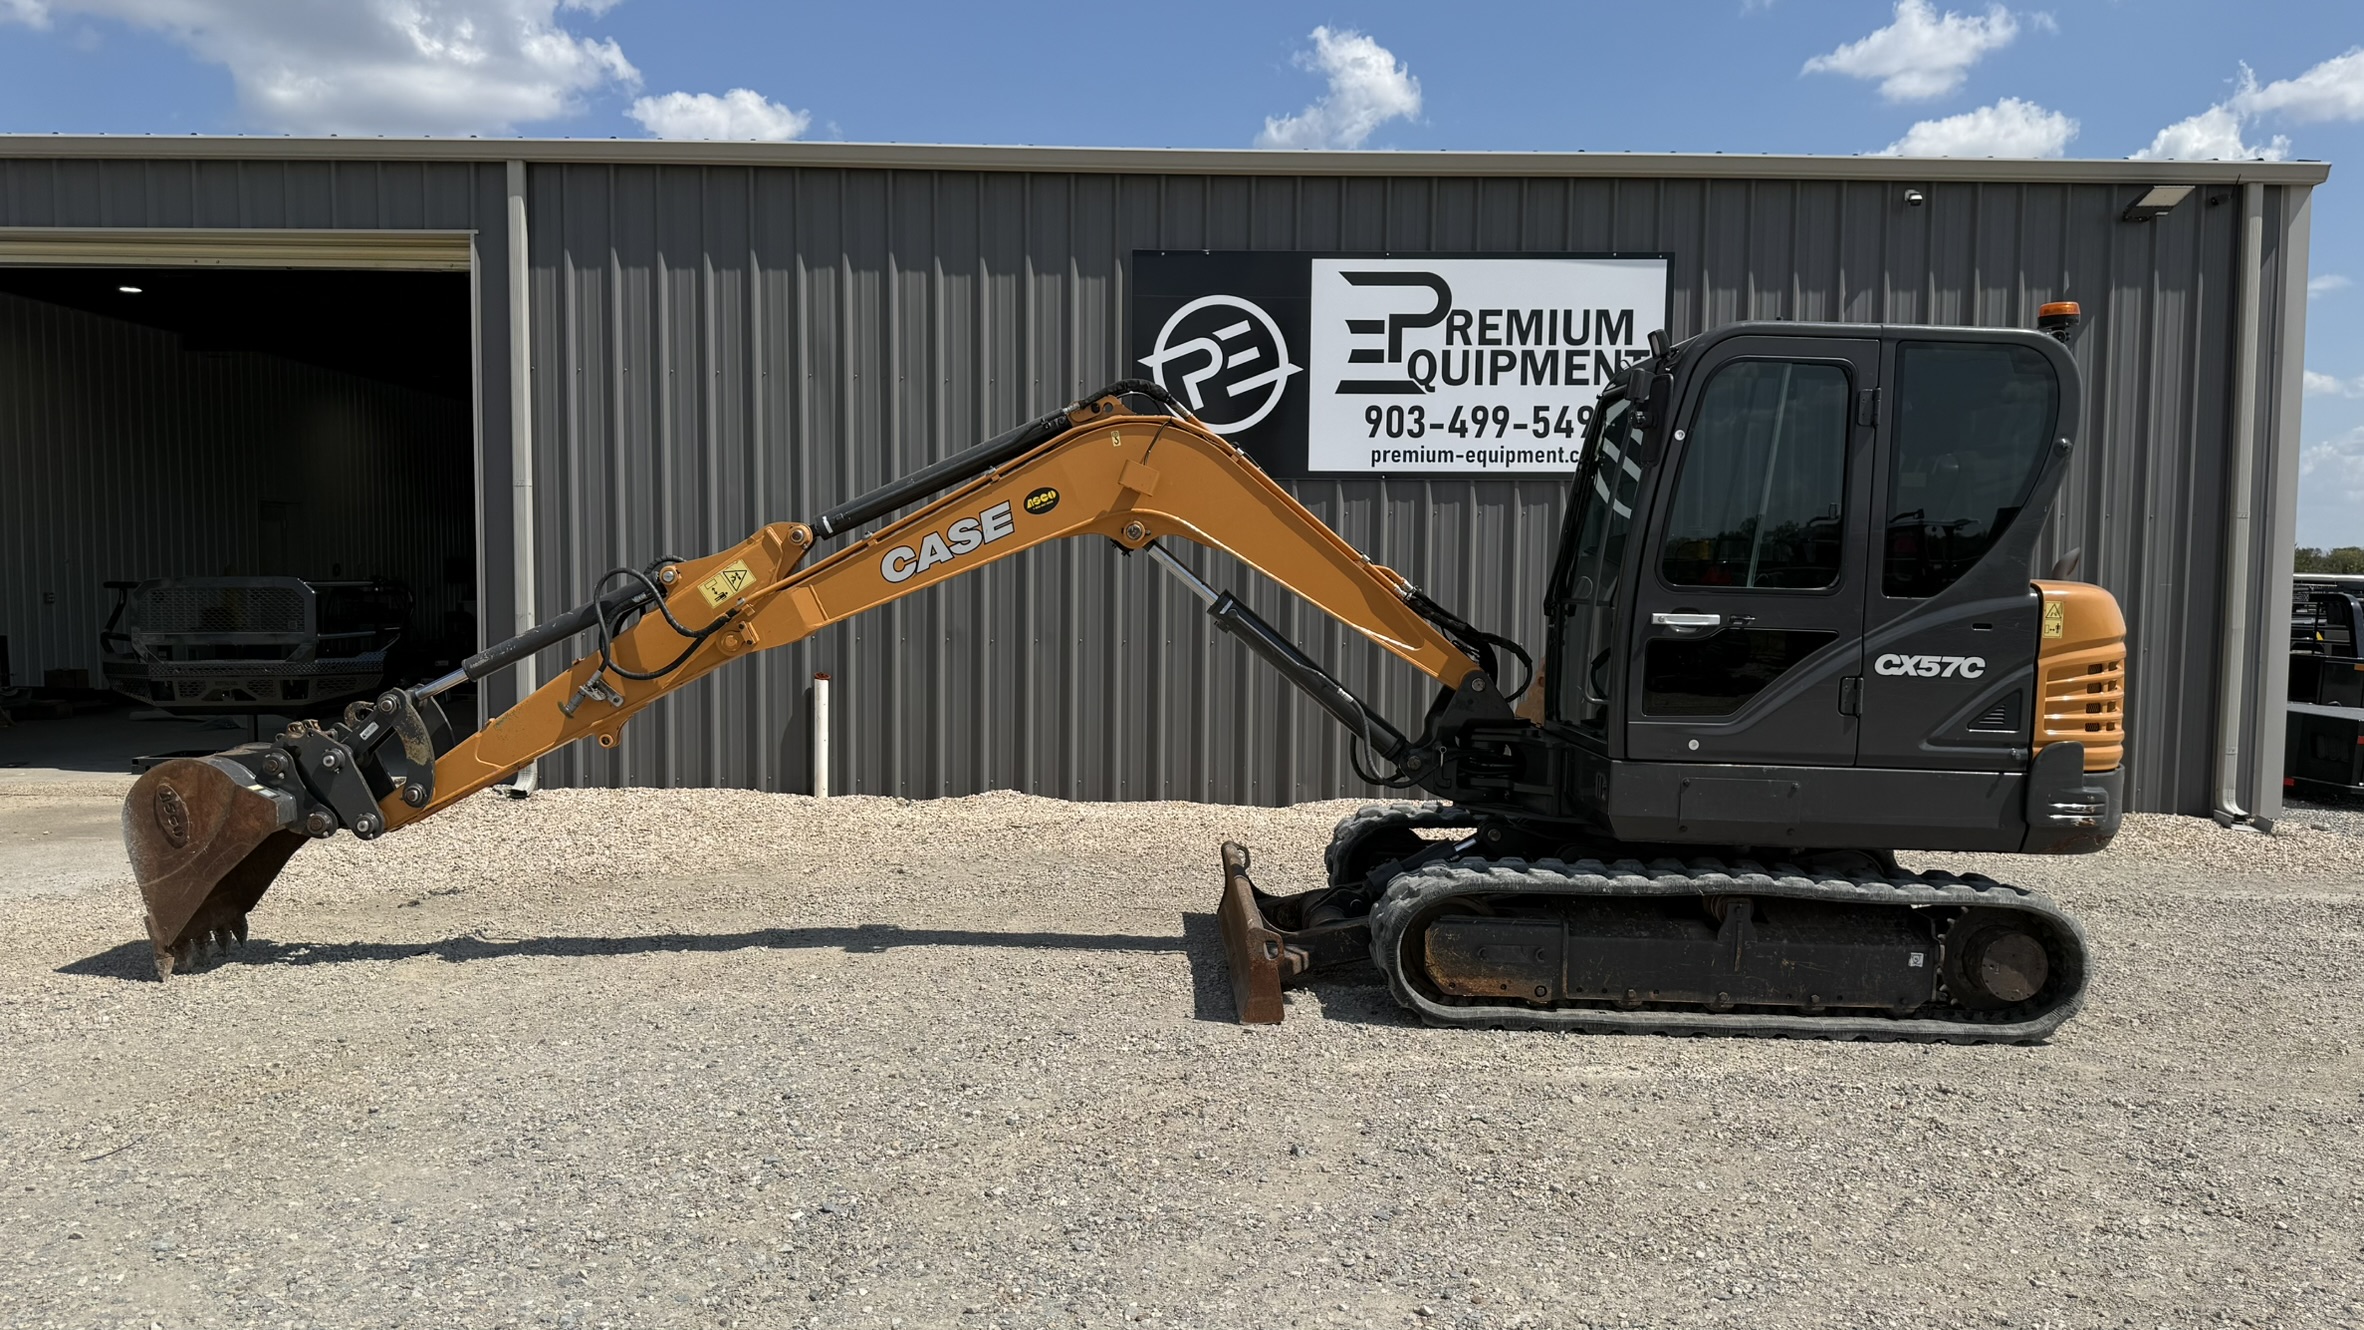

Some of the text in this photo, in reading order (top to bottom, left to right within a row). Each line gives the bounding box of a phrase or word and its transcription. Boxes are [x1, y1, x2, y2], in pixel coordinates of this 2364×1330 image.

[1026, 490, 1057, 509] ASCO
[880, 500, 1015, 583] CASE
[1874, 653, 1986, 679] CX57C
